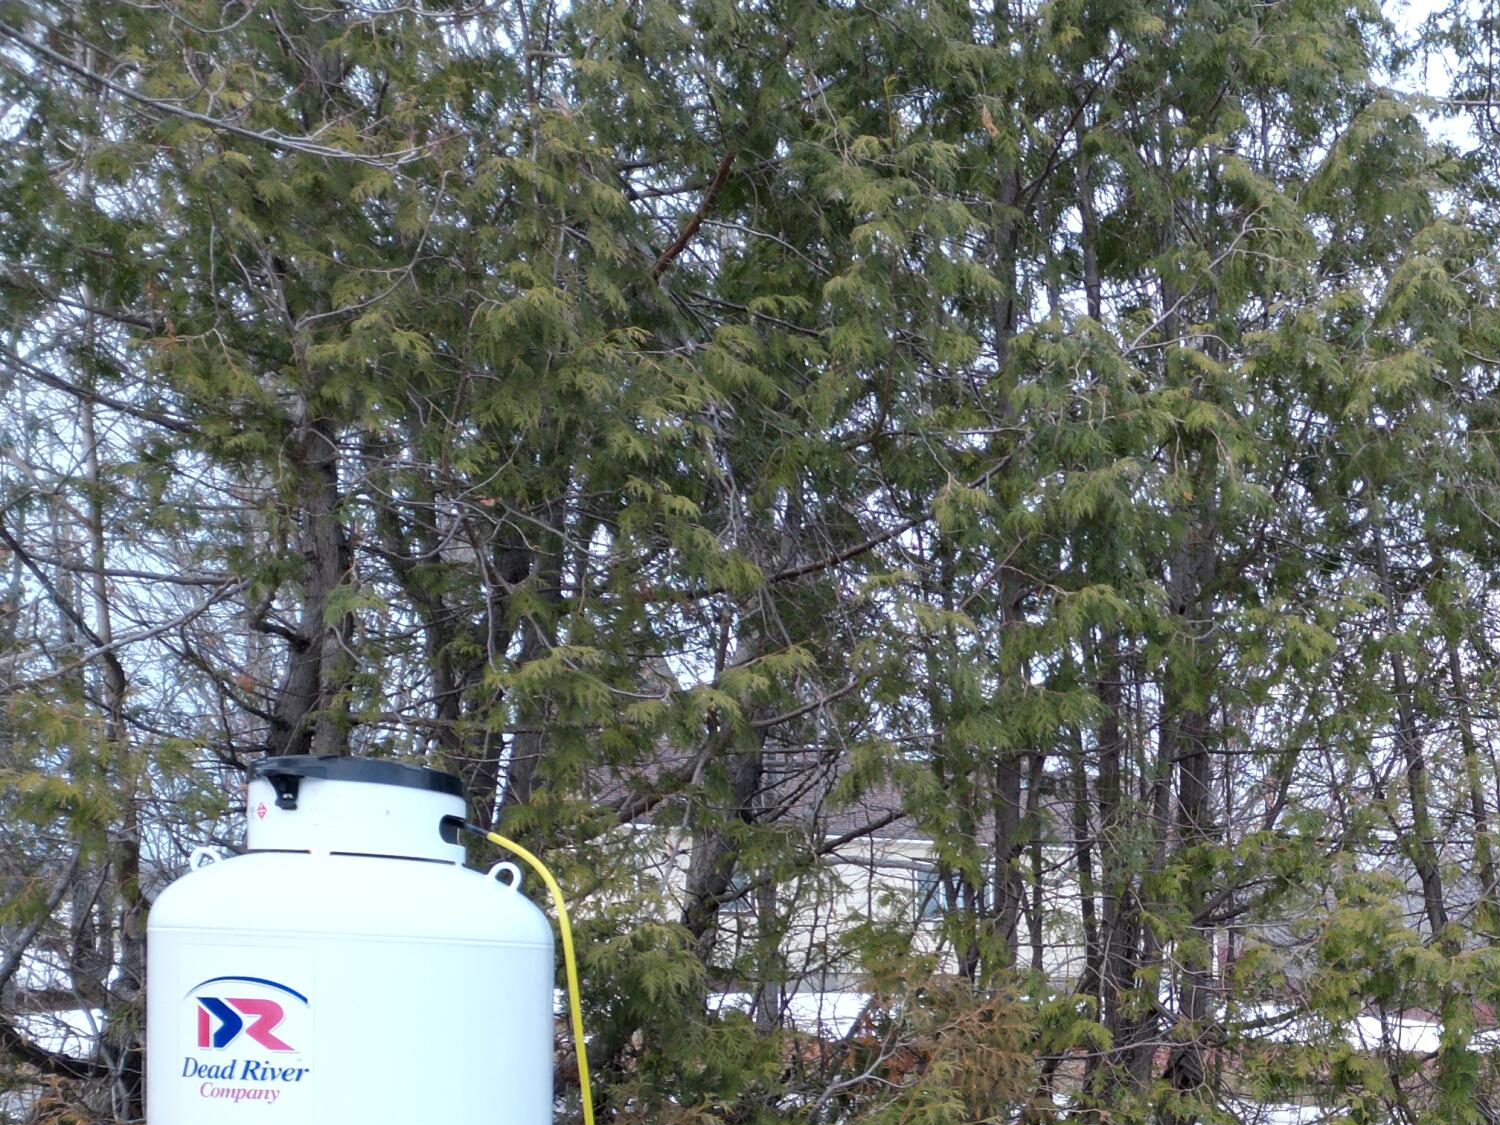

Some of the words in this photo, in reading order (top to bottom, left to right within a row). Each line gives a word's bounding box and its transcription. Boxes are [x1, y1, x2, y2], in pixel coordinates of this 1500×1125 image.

[196, 997, 295, 1051] DR
[182, 1057, 237, 1080] Dead
[240, 1060, 309, 1082] River
[200, 1082, 280, 1104] Company
